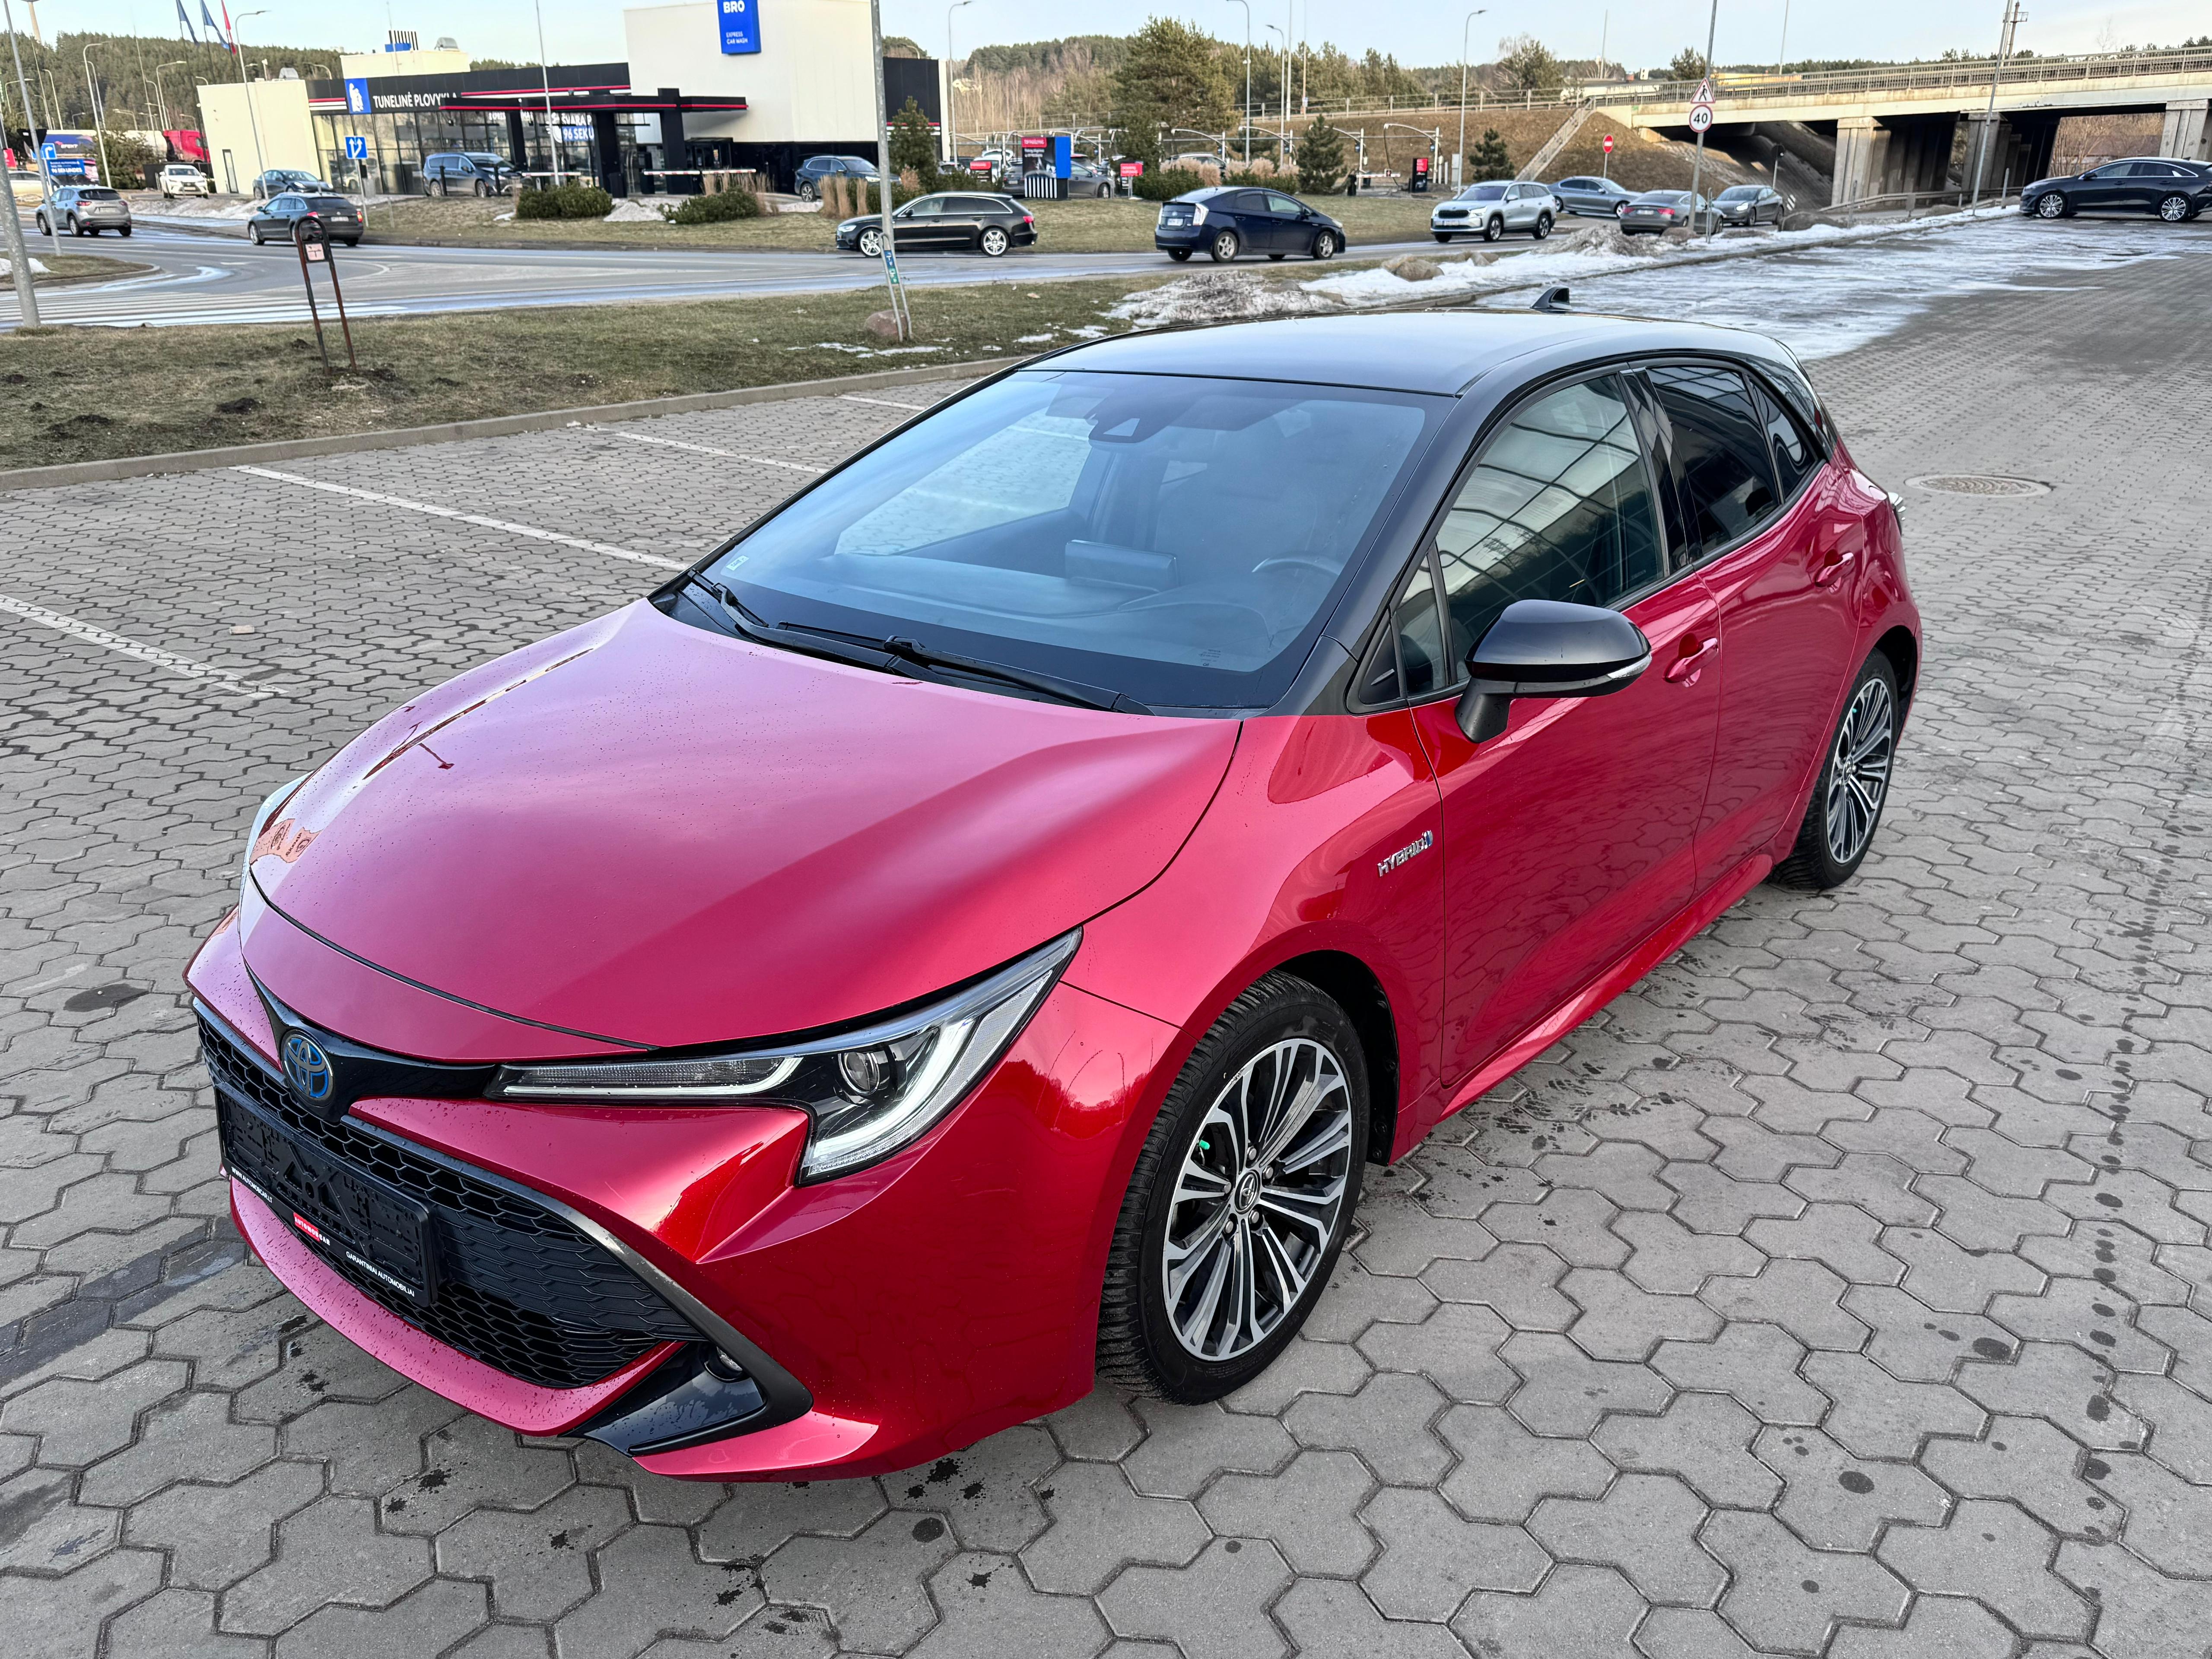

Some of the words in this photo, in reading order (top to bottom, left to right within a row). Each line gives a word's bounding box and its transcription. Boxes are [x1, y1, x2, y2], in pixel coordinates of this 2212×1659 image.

[723, 0, 745, 13] BRO
[373, 92, 413, 108] TUNELINĖ
[413, 92, 457, 107] PLOVY
[1694, 113, 1708, 124] 40
[563, 128, 573, 140] 96
[1377, 837, 1426, 877] HYBRID
[294, 1216, 330, 1246] AUTOMOBCAR
[346, 1251, 377, 1275] GARANTINIAI
[378, 1271, 415, 1297] AUTOMOBILIAI
